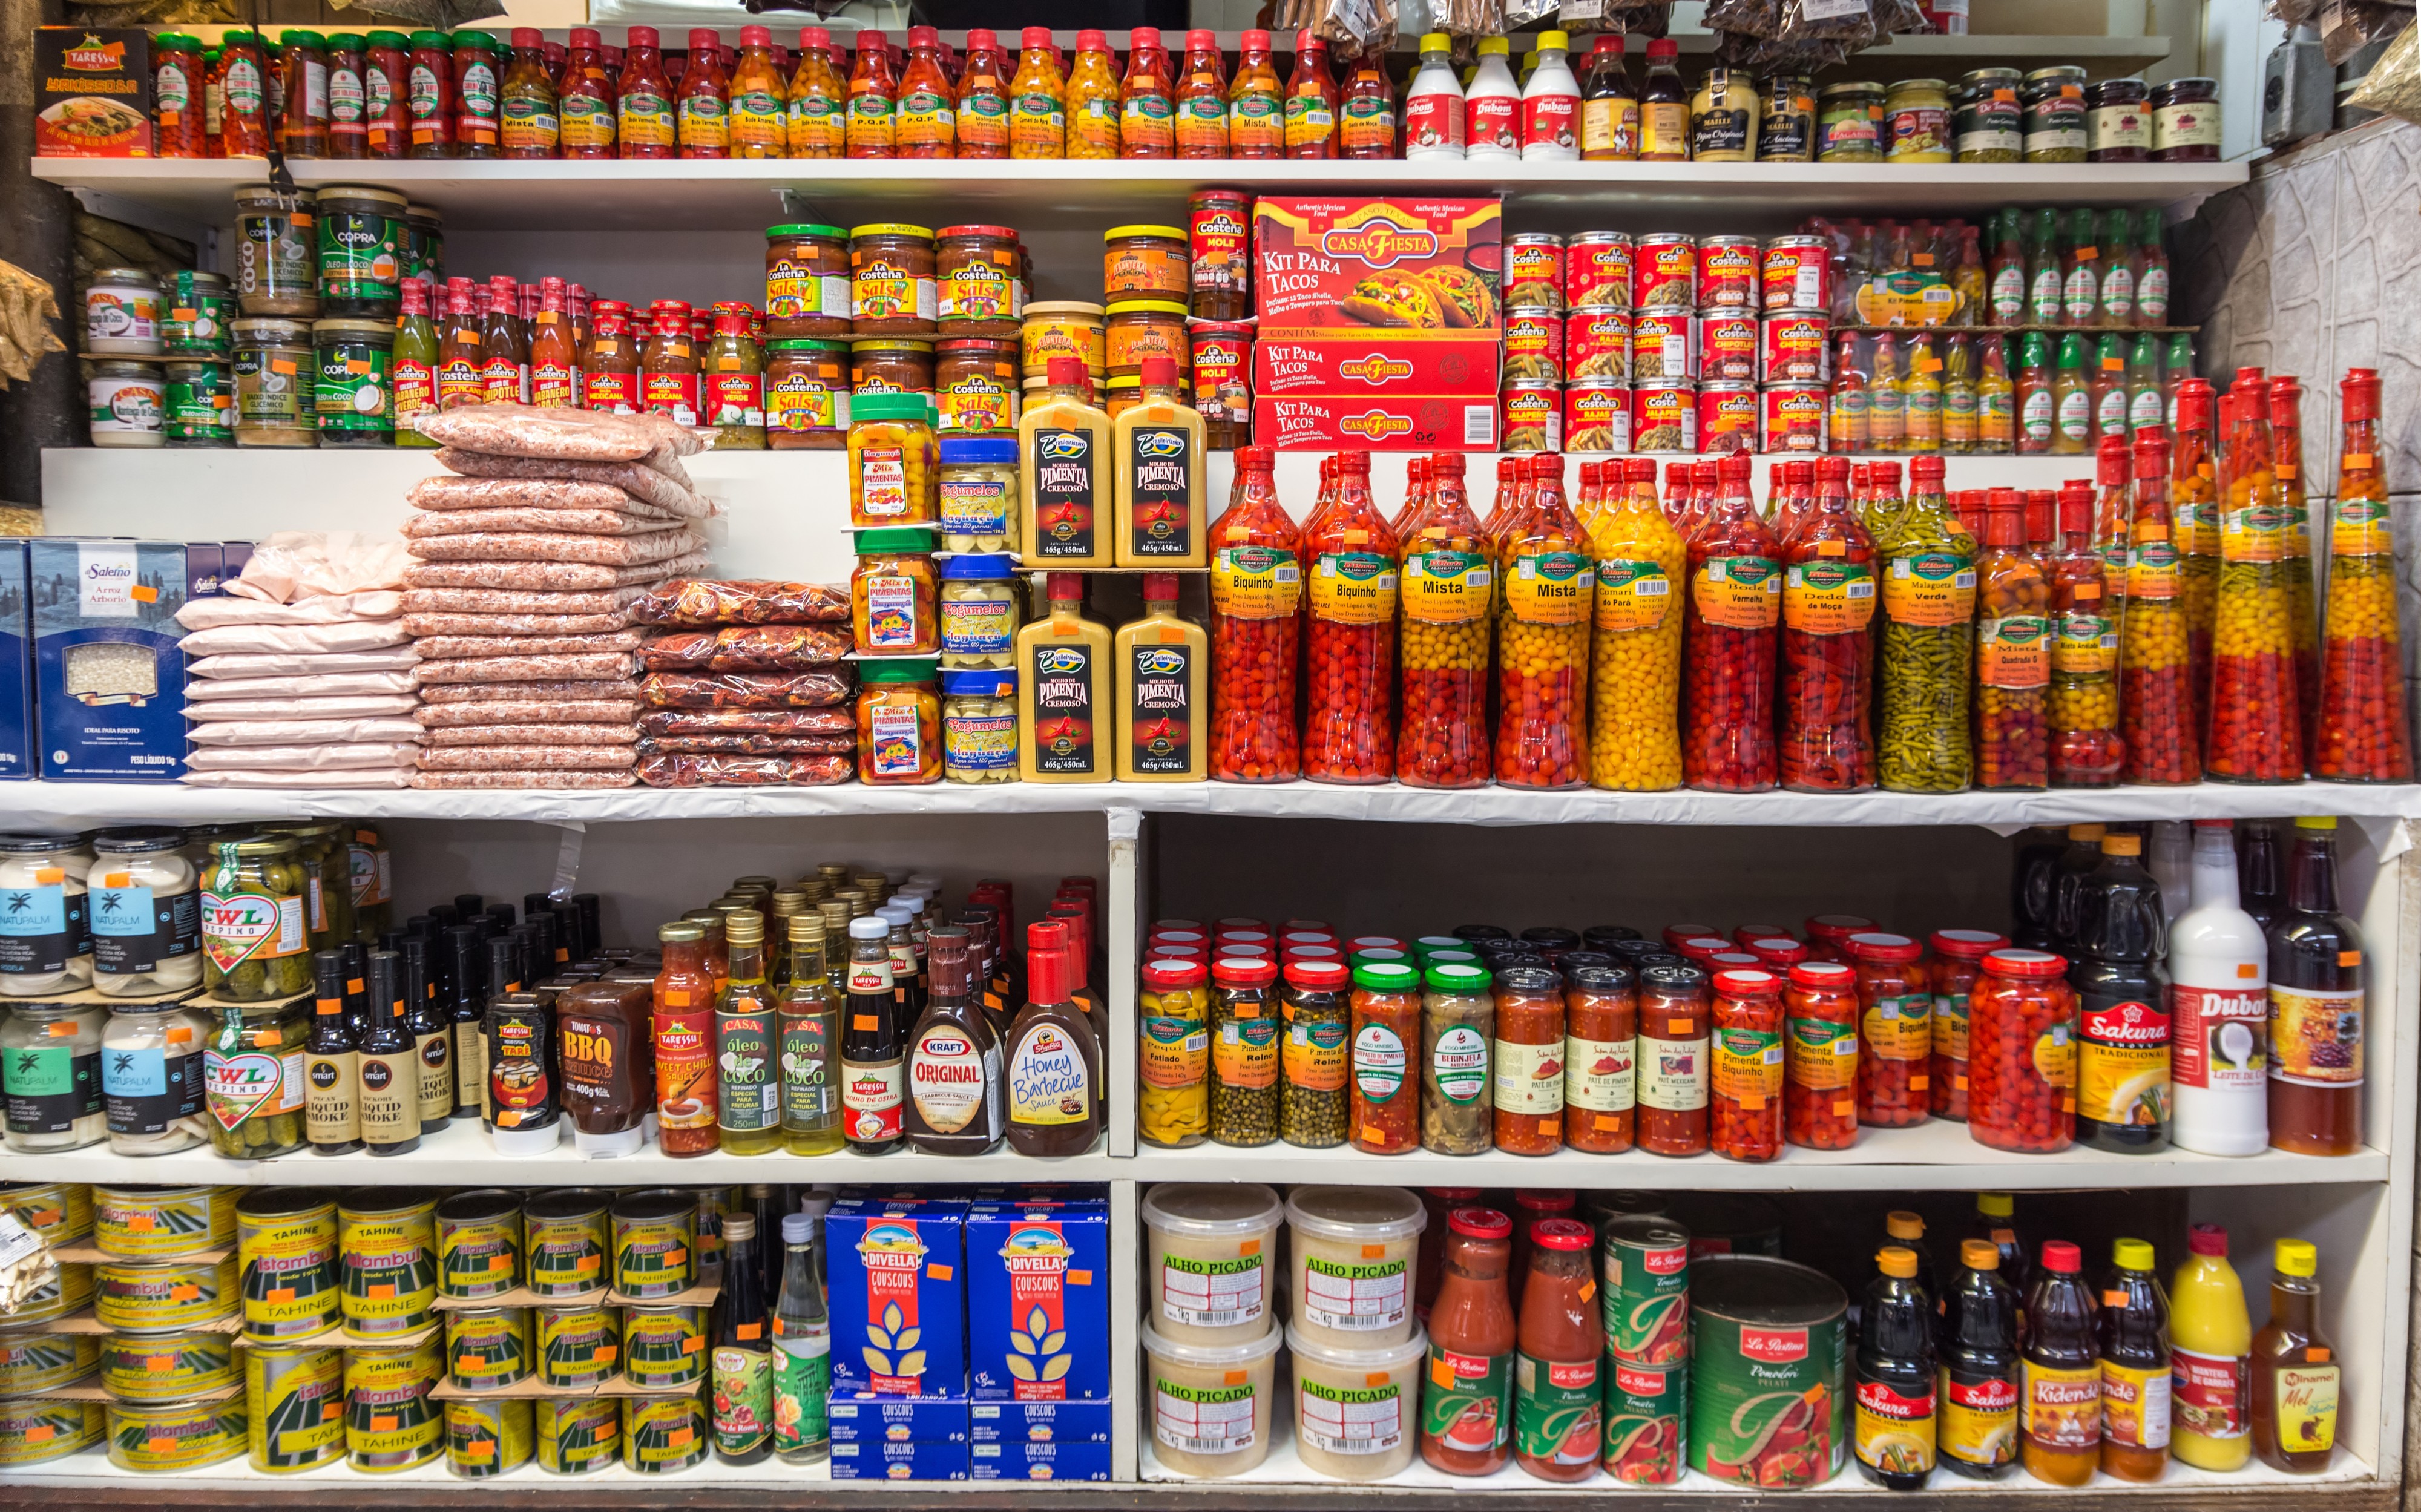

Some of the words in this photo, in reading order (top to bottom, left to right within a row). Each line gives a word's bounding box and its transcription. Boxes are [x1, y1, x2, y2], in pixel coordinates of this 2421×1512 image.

[1477, 104, 1511, 113] Dubom
[1696, 132, 1712, 142] Dijon
[1712, 130, 1745, 139] Originale
[1200, 224, 1242, 234] Costeña
[338, 232, 377, 243] COPRA
[1207, 238, 1235, 248] MOLE
[1327, 237, 1367, 251] CASA
[243, 241, 254, 294] COCO
[326, 260, 344, 269] ÓLEO
[1114, 261, 1147, 273] FRONTERA
[1263, 252, 1294, 272] KIT
[1298, 252, 1341, 275] PARA
[769, 270, 806, 280] Costeña
[956, 271, 1000, 280] Costeña
[770, 282, 806, 297] Salsa
[1267, 274, 1318, 294] TACOS
[1266, 298, 1289, 307] Incluso:
[1271, 327, 1318, 337] CONTÉM:
[235, 362, 258, 370] COPRA
[394, 370, 427, 379] Costeña
[119, 388, 154, 398] CASA
[266, 392, 287, 401] ÍNDICE
[484, 385, 519, 401] CHIPOTLE
[399, 398, 422, 412] VERDE
[873, 464, 893, 473] Mix
[1041, 468, 1088, 491] PIMENTA
[1045, 546, 1087, 554] 465g/450mL
[1234, 576, 1273, 591] Biquinho
[1423, 582, 1463, 594] Mista
[1912, 582, 1951, 590] Malagueta
[1599, 588, 1631, 596] Cumari
[1733, 594, 1762, 603] Vermelha
[950, 720, 1011, 732] Cogumelos
[145, 754, 165, 764] LÍQUIDO
[166, 756, 175, 766] 1kg
[95, 915, 140, 925] NATUPALM
[202, 909, 262, 925] CWL
[205, 925, 254, 935] PEPINO
[725, 1019, 758, 1031] CASA
[2089, 1017, 2166, 1040] Sakura
[501, 1046, 530, 1056] TARÊ
[564, 1031, 613, 1067] BBQ
[728, 1039, 759, 1052] óleo
[930, 1043, 962, 1052] KRAFT
[1147, 1043, 1182, 1052] Pequi
[1241, 1044, 1267, 1053] Pimenta
[1151, 1053, 1180, 1063] Fatiado
[1247, 1053, 1273, 1062] Reino
[1442, 1053, 1482, 1062] BERINJELA
[2095, 1048, 2164, 1059] TRADICIONAL
[686, 1056, 714, 1071] CHILLI
[734, 1054, 752, 1068] de
[1724, 1054, 1761, 1066] Pimenta
[565, 1060, 613, 1079] sauce
[916, 1062, 980, 1085] ORIGINAL
[1022, 1055, 1072, 1080] Honey
[1722, 1063, 1763, 1076] Biquinho
[312, 1070, 335, 1082] smart
[666, 1073, 694, 1081] SAUCE
[724, 1070, 766, 1084] COCO
[576, 1084, 594, 1096] 400g
[1014, 1073, 1084, 1104] Barbecue
[306, 1102, 349, 1113] LIQUID
[1029, 1097, 1057, 1112] sauce
[733, 1119, 758, 1128] 250ml
[273, 1226, 319, 1240] TAHINE
[869, 1253, 913, 1268] DIVELLA
[1165, 1257, 1203, 1273] ALHO
[1210, 1255, 1263, 1274] PICADO
[277, 1272, 300, 1281] Desde
[872, 1272, 913, 1289] COUSCOUS
[265, 1295, 331, 1317] TAHINE
[1178, 1309, 1189, 1324] 1kg
[1745, 1336, 1763, 1350] La
[1765, 1339, 1804, 1352] Pastina
[1750, 1364, 1799, 1378] Pomodori
[2038, 1384, 2099, 1403] Kidendê
[2282, 1390, 2309, 1409] Mel
